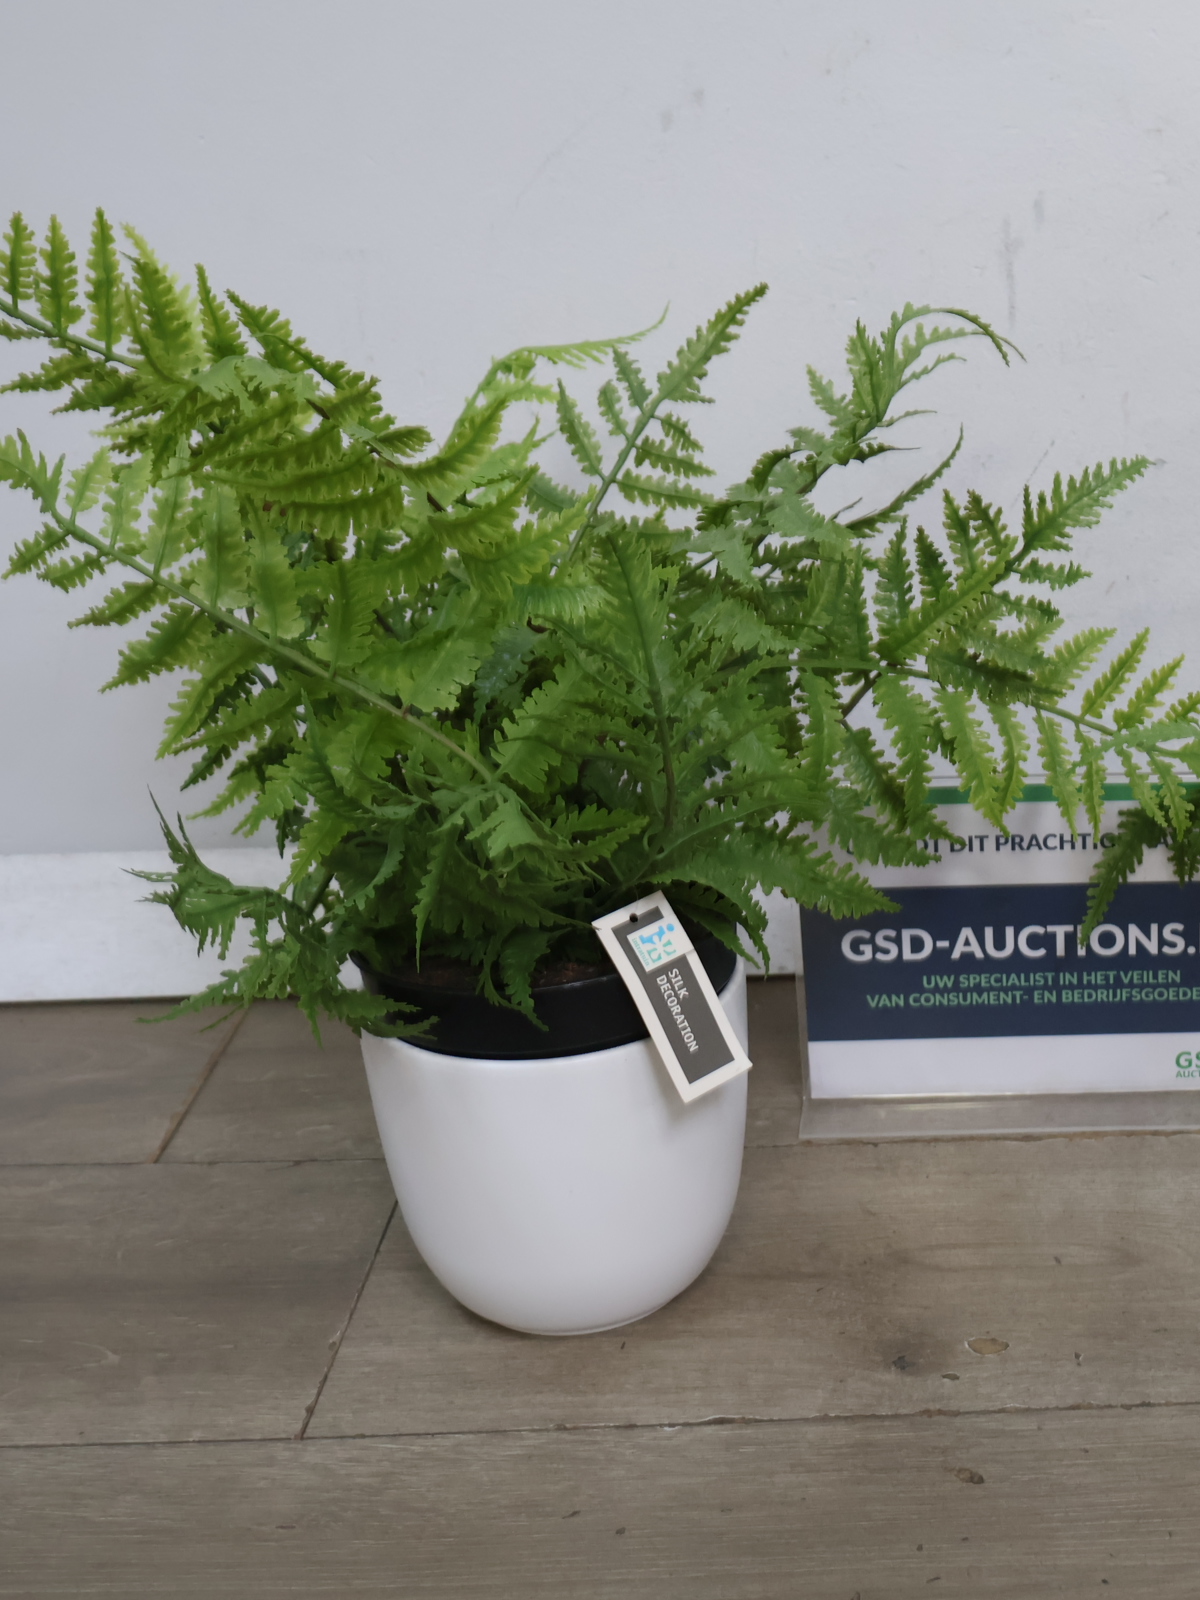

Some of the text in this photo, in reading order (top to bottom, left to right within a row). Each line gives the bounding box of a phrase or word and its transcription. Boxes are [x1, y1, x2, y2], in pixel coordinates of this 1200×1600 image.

[950, 835, 989, 852] DIT
[668, 967, 689, 1000] SILK
[923, 970, 1181, 988] UW SPECIALIST IN HET VEILEN
[867, 994, 904, 1007] VAN
[909, 991, 1029, 1007] CONSUMENT-
[1033, 990, 1057, 1004] EN
[656, 974, 699, 1053] DECORATION
